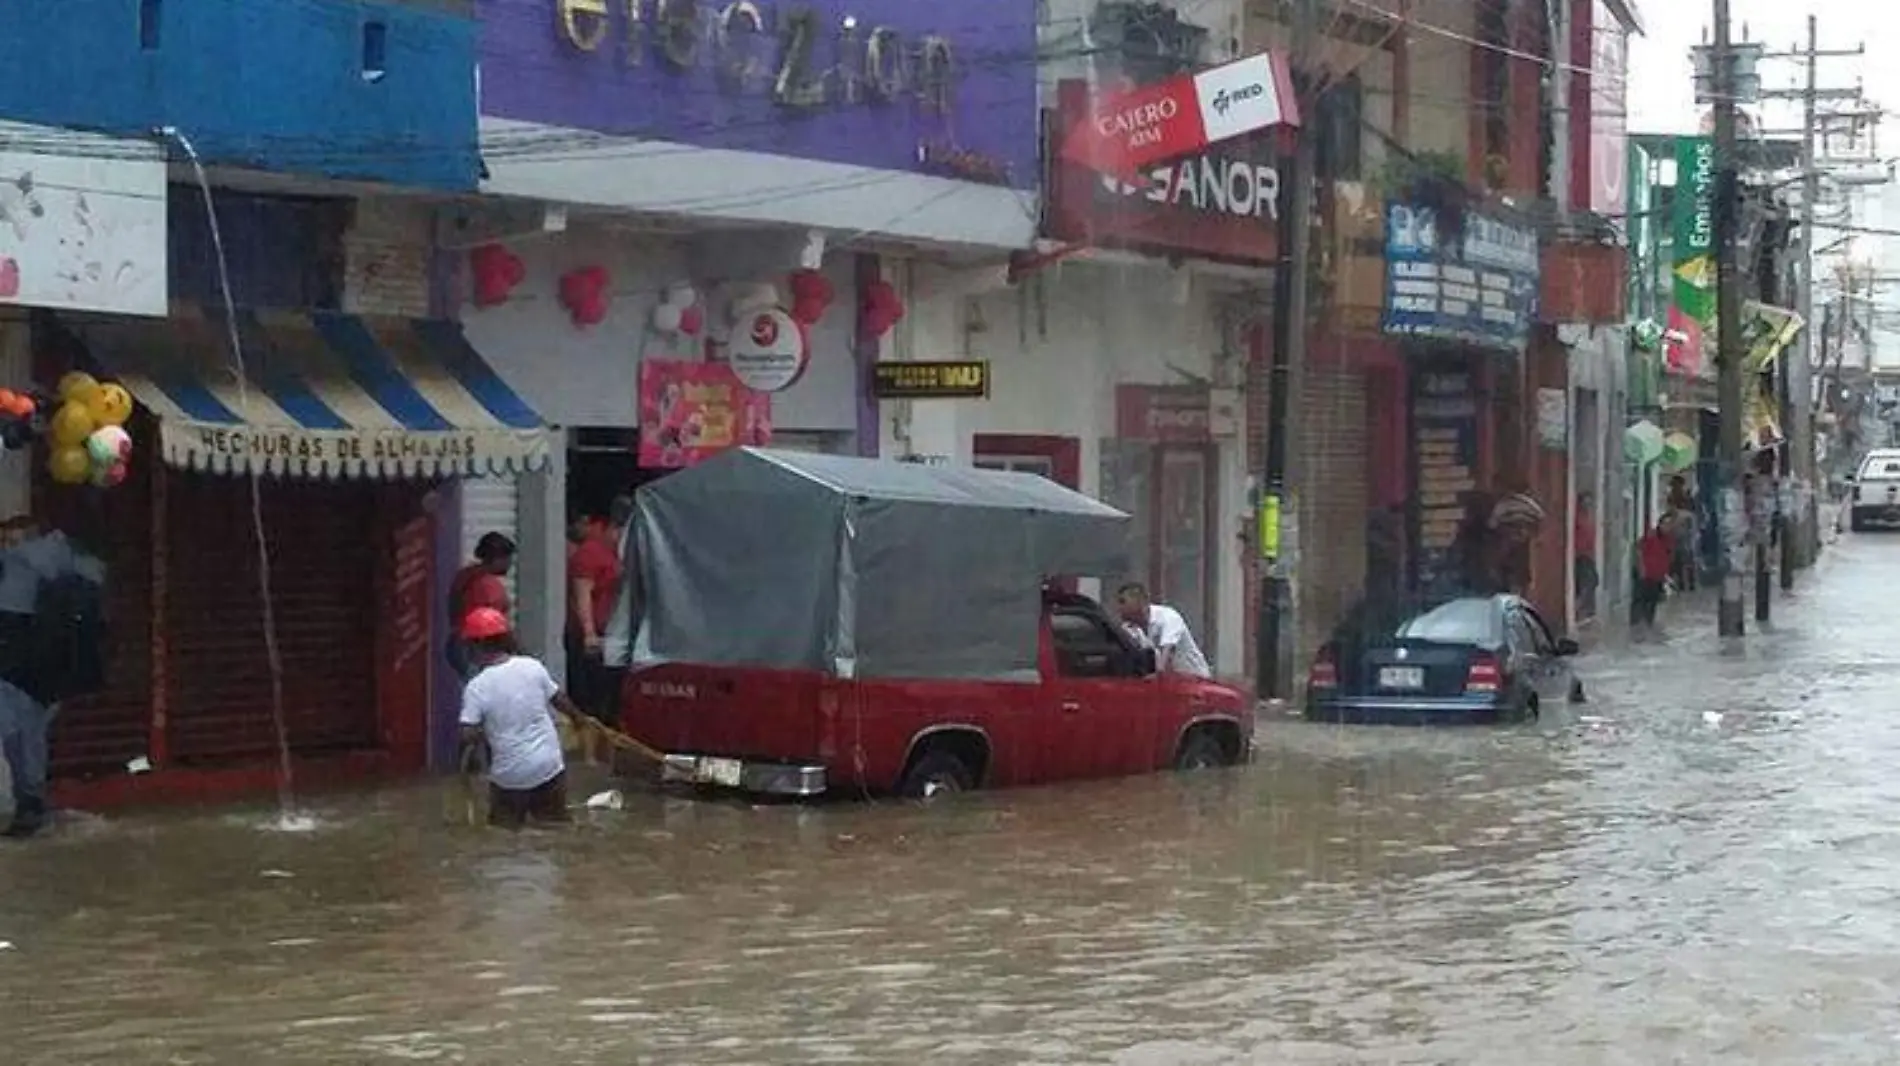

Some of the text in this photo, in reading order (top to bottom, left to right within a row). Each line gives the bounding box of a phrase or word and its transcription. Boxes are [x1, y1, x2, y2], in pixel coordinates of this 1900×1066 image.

[1098, 96, 1177, 137] CAJERO
[1128, 127, 1162, 149] ATM
[201, 429, 475, 459] HECHURAS DE ALHAJAS
